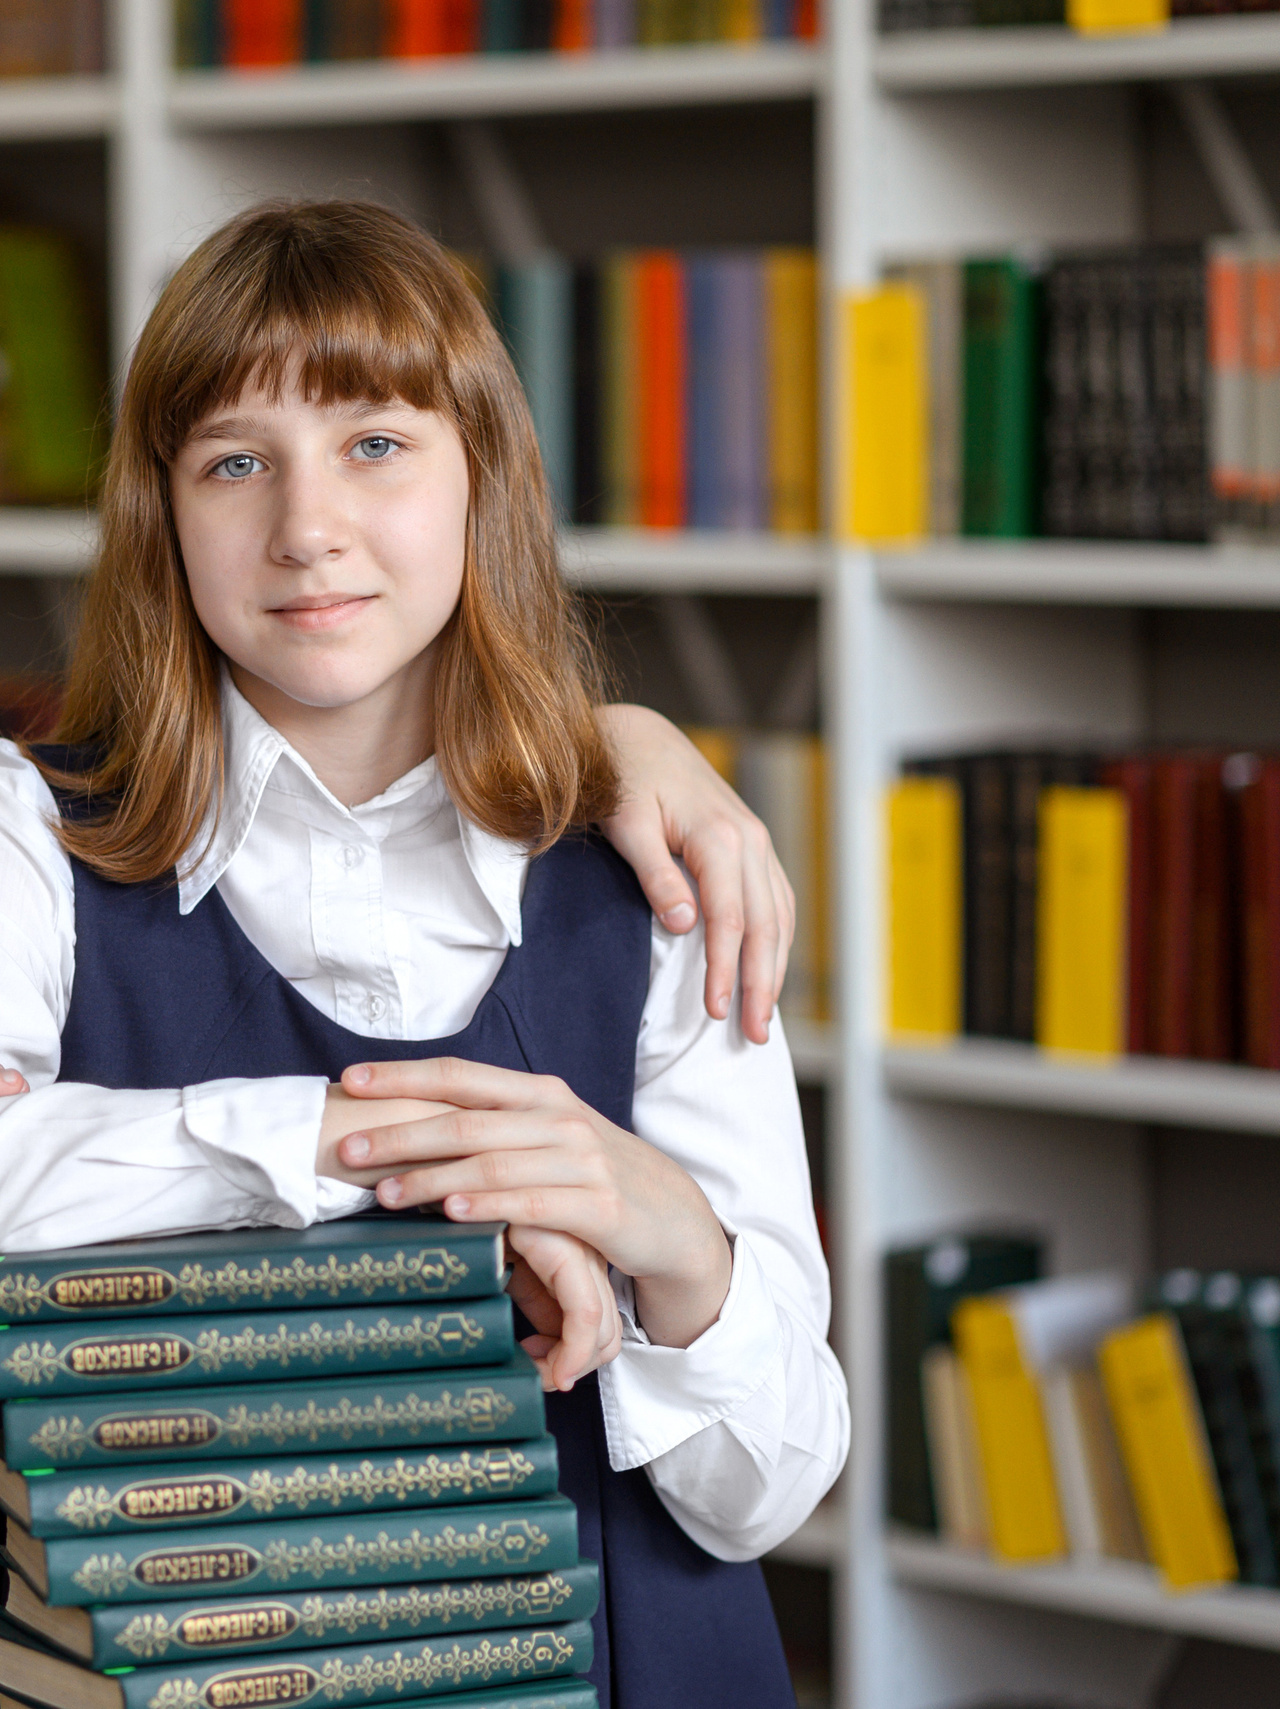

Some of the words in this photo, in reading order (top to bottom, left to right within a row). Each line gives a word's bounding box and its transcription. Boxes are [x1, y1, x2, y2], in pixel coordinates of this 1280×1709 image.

[421, 1263, 445, 1279] 2
[441, 1331, 462, 1341] 1
[470, 1395, 492, 1422] 12
[488, 1461, 510, 1482] 11
[504, 1534, 526, 1550] 3
[530, 1581, 550, 1605] 10
